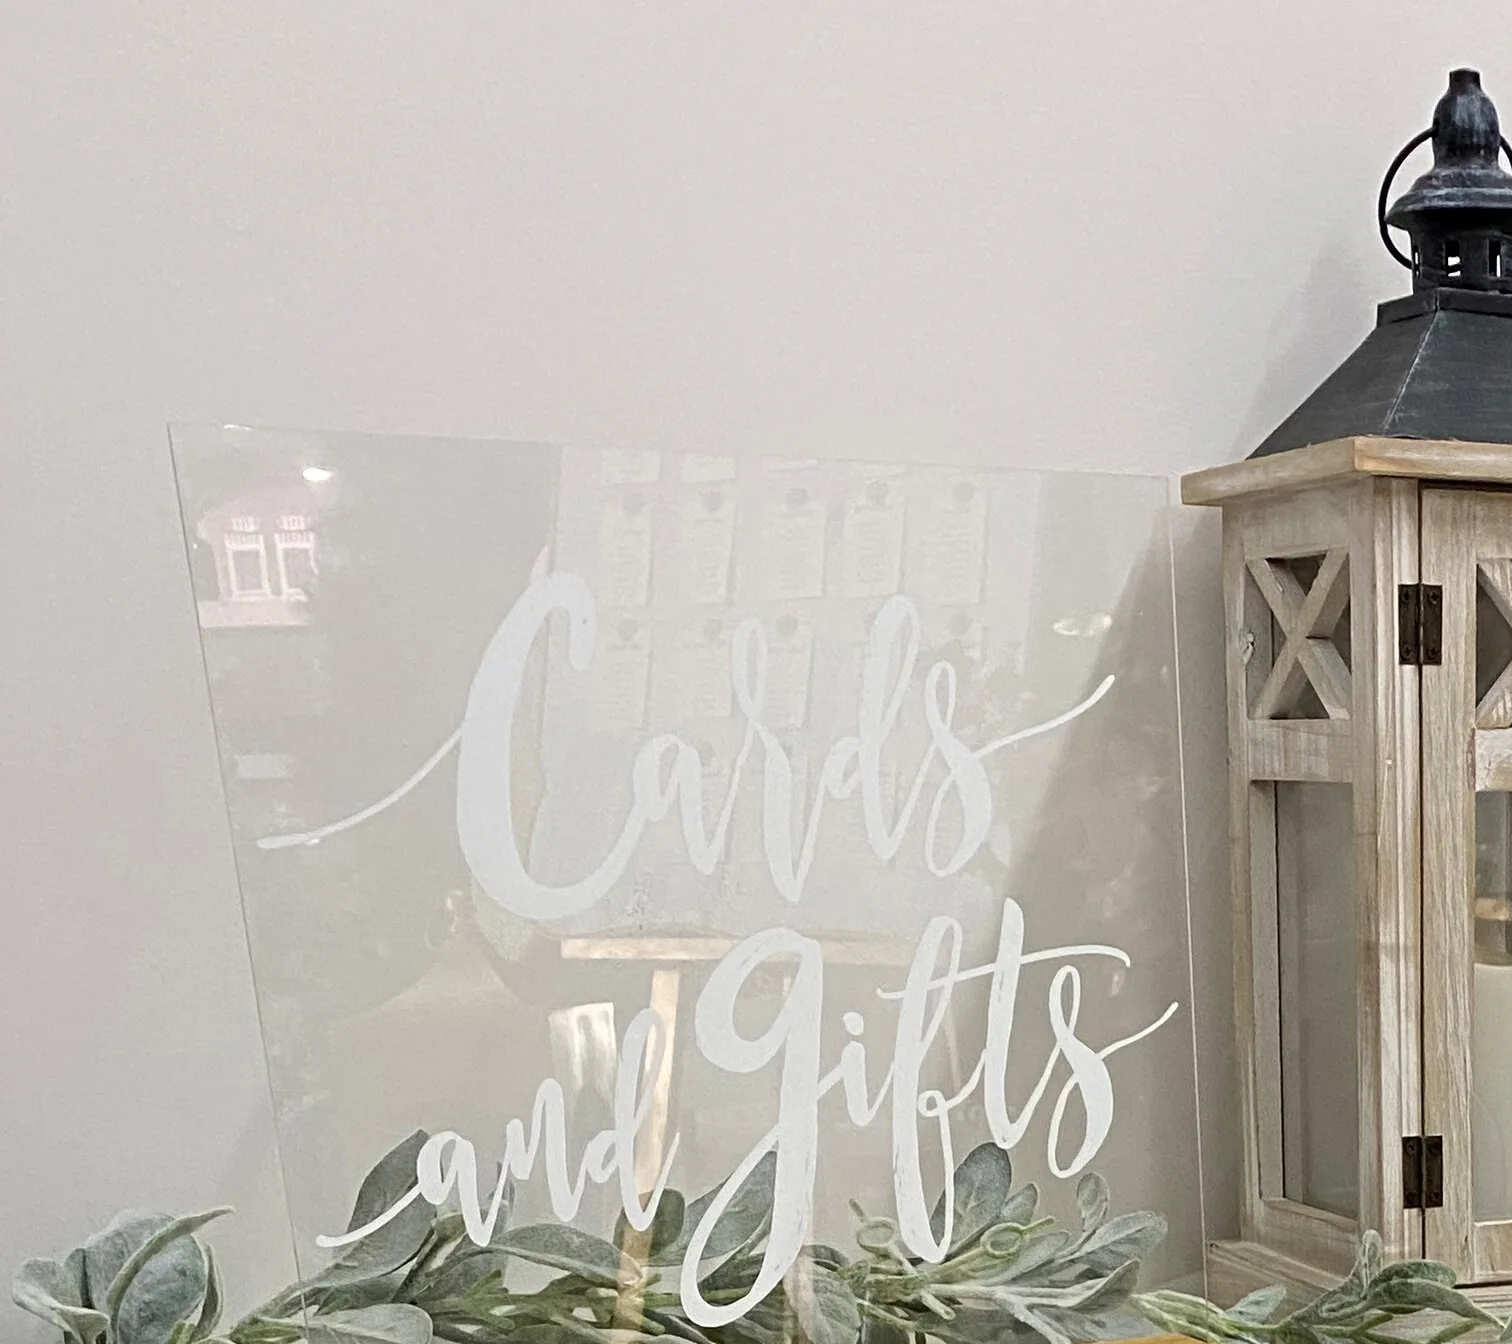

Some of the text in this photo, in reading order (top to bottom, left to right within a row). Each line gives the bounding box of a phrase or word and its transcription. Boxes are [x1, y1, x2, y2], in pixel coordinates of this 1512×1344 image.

[258, 573, 1116, 920] Cards
[316, 897, 1178, 1328] and gifts
